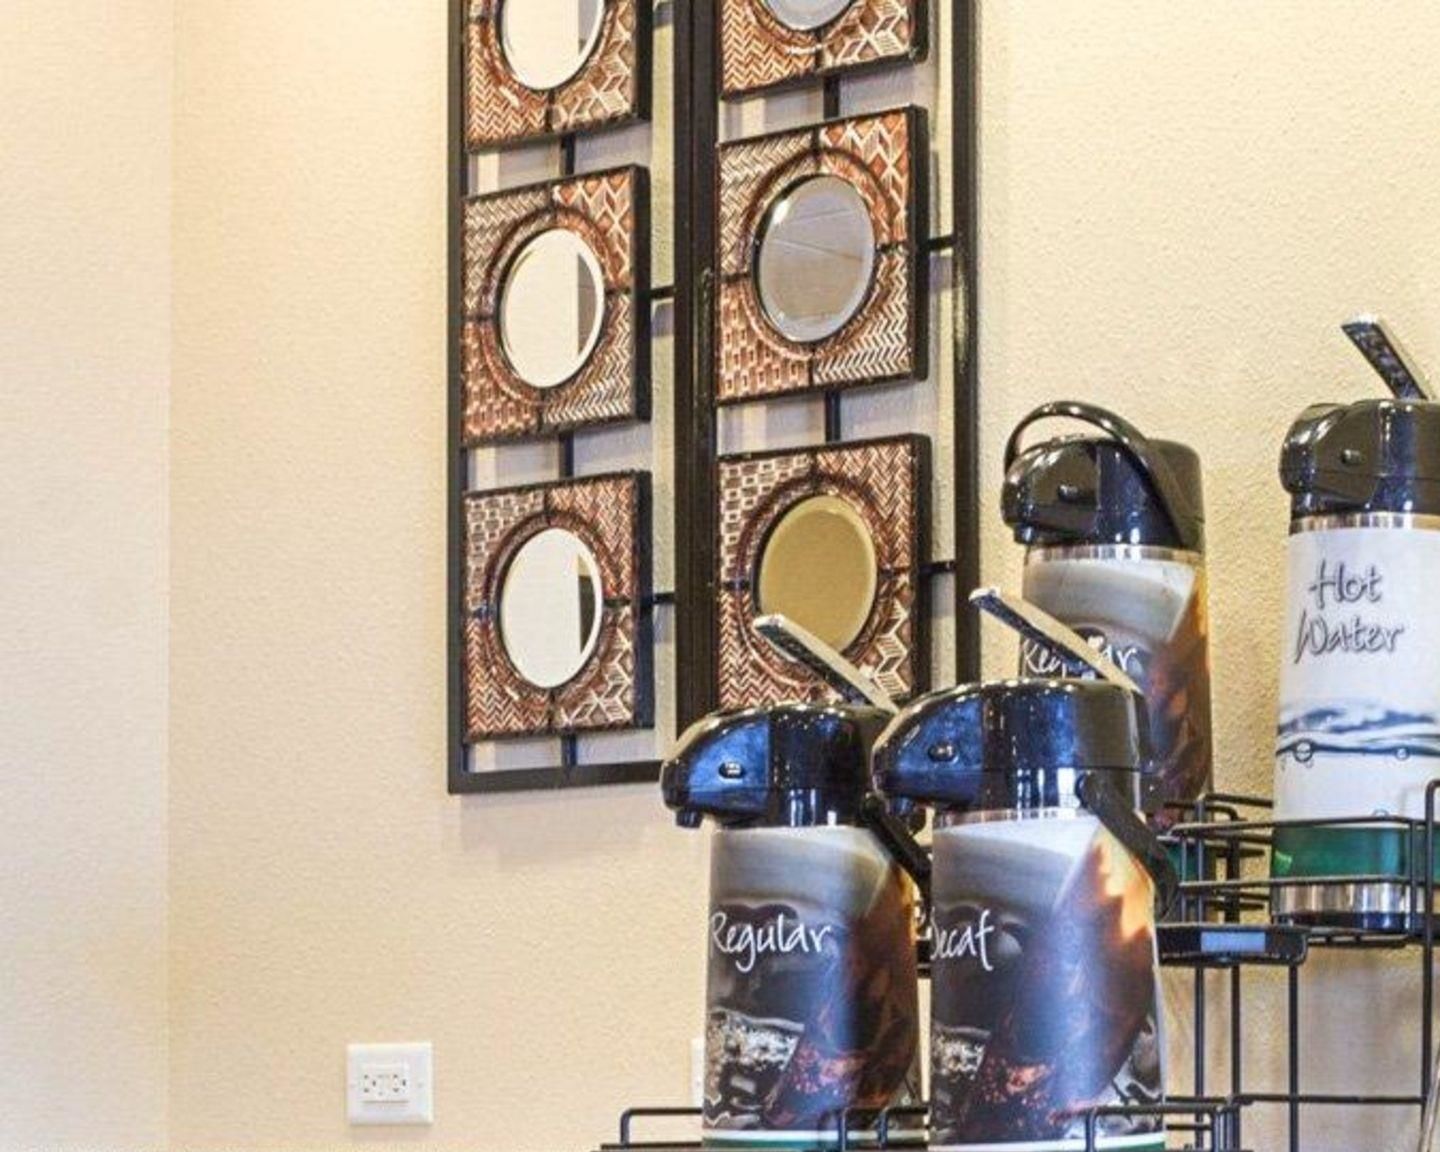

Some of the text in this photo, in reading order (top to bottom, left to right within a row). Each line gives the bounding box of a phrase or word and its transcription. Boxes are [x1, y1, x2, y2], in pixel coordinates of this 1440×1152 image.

[1308, 558, 1383, 611] Hot
[1021, 637, 1137, 679] Rear
[1293, 608, 1405, 664] Water
[709, 911, 832, 973] Regular
